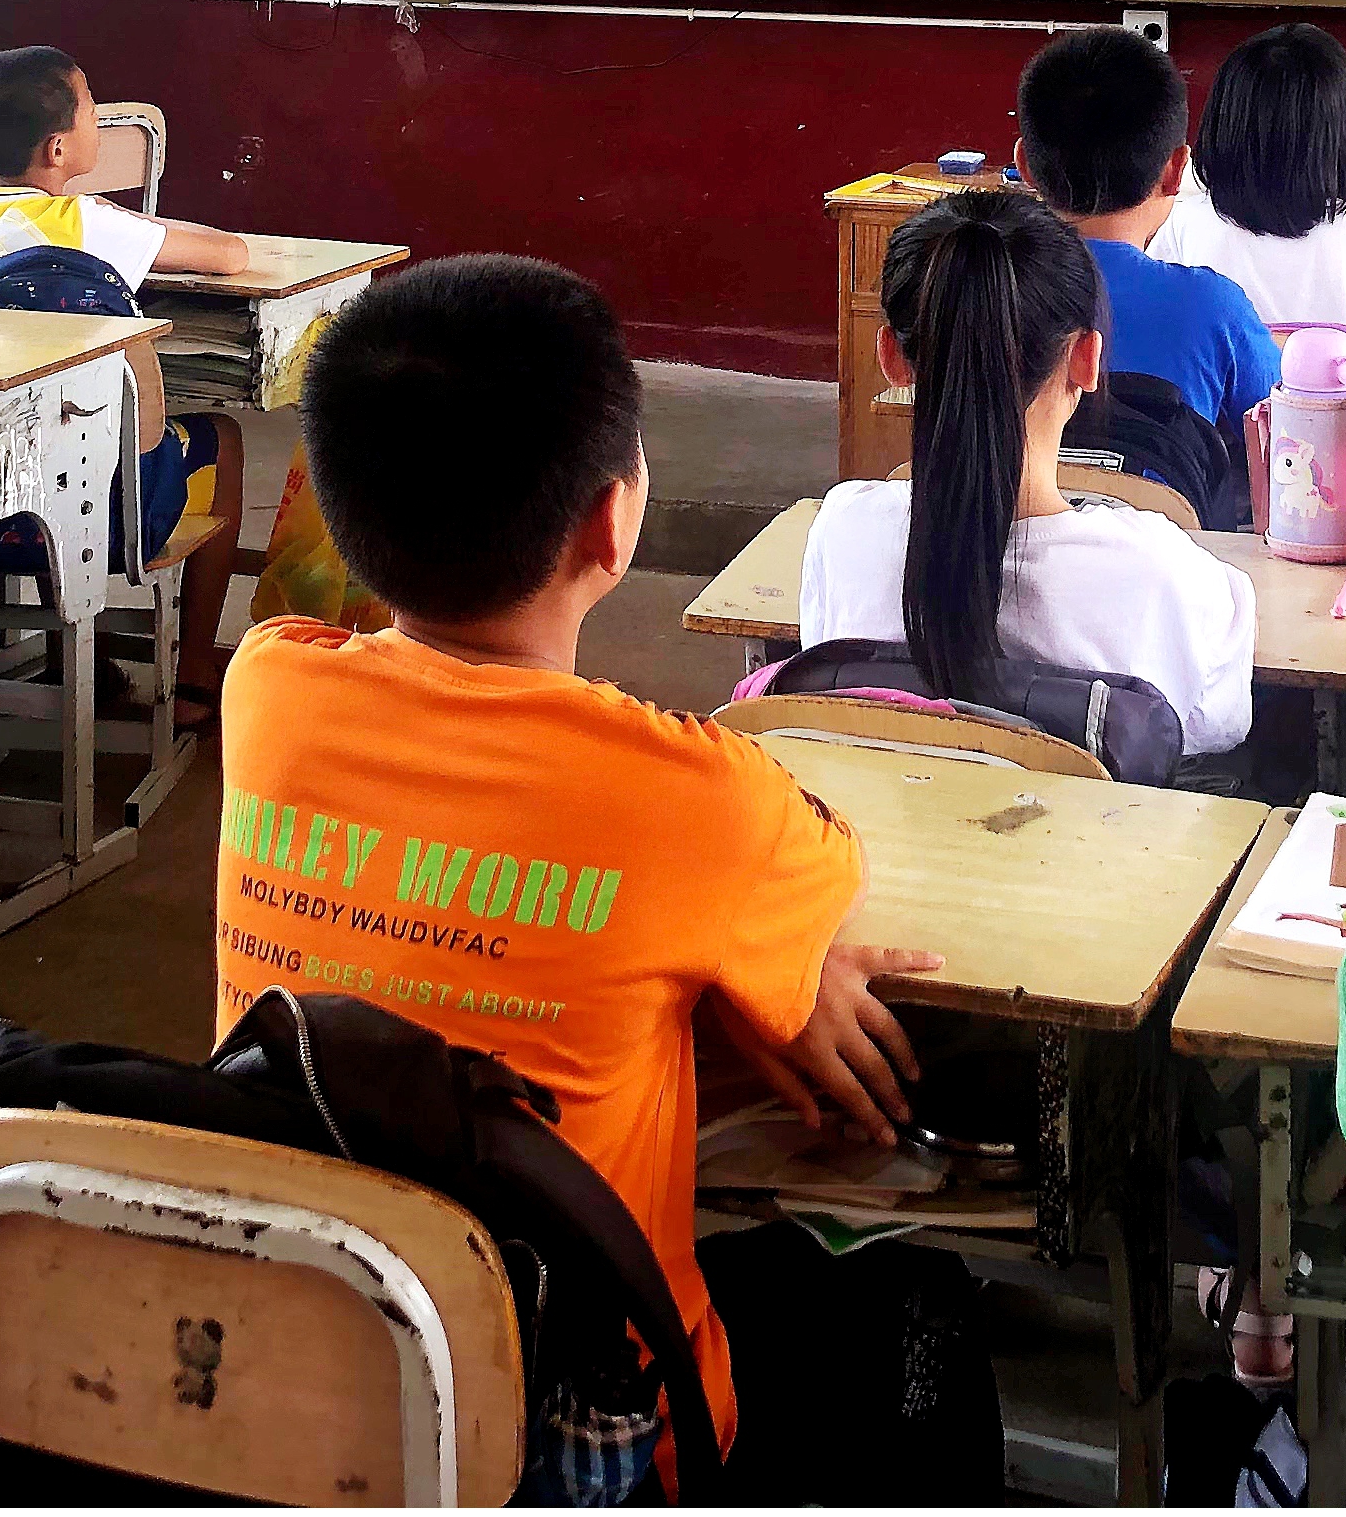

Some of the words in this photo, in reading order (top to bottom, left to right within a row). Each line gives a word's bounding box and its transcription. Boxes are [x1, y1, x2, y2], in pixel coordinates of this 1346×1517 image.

[240, 873, 345, 925] MOLYBDY
[350, 907, 509, 960] WAUDVFAC
[381, 973, 454, 1007] JUST
[456, 988, 567, 1024] ABOUT
